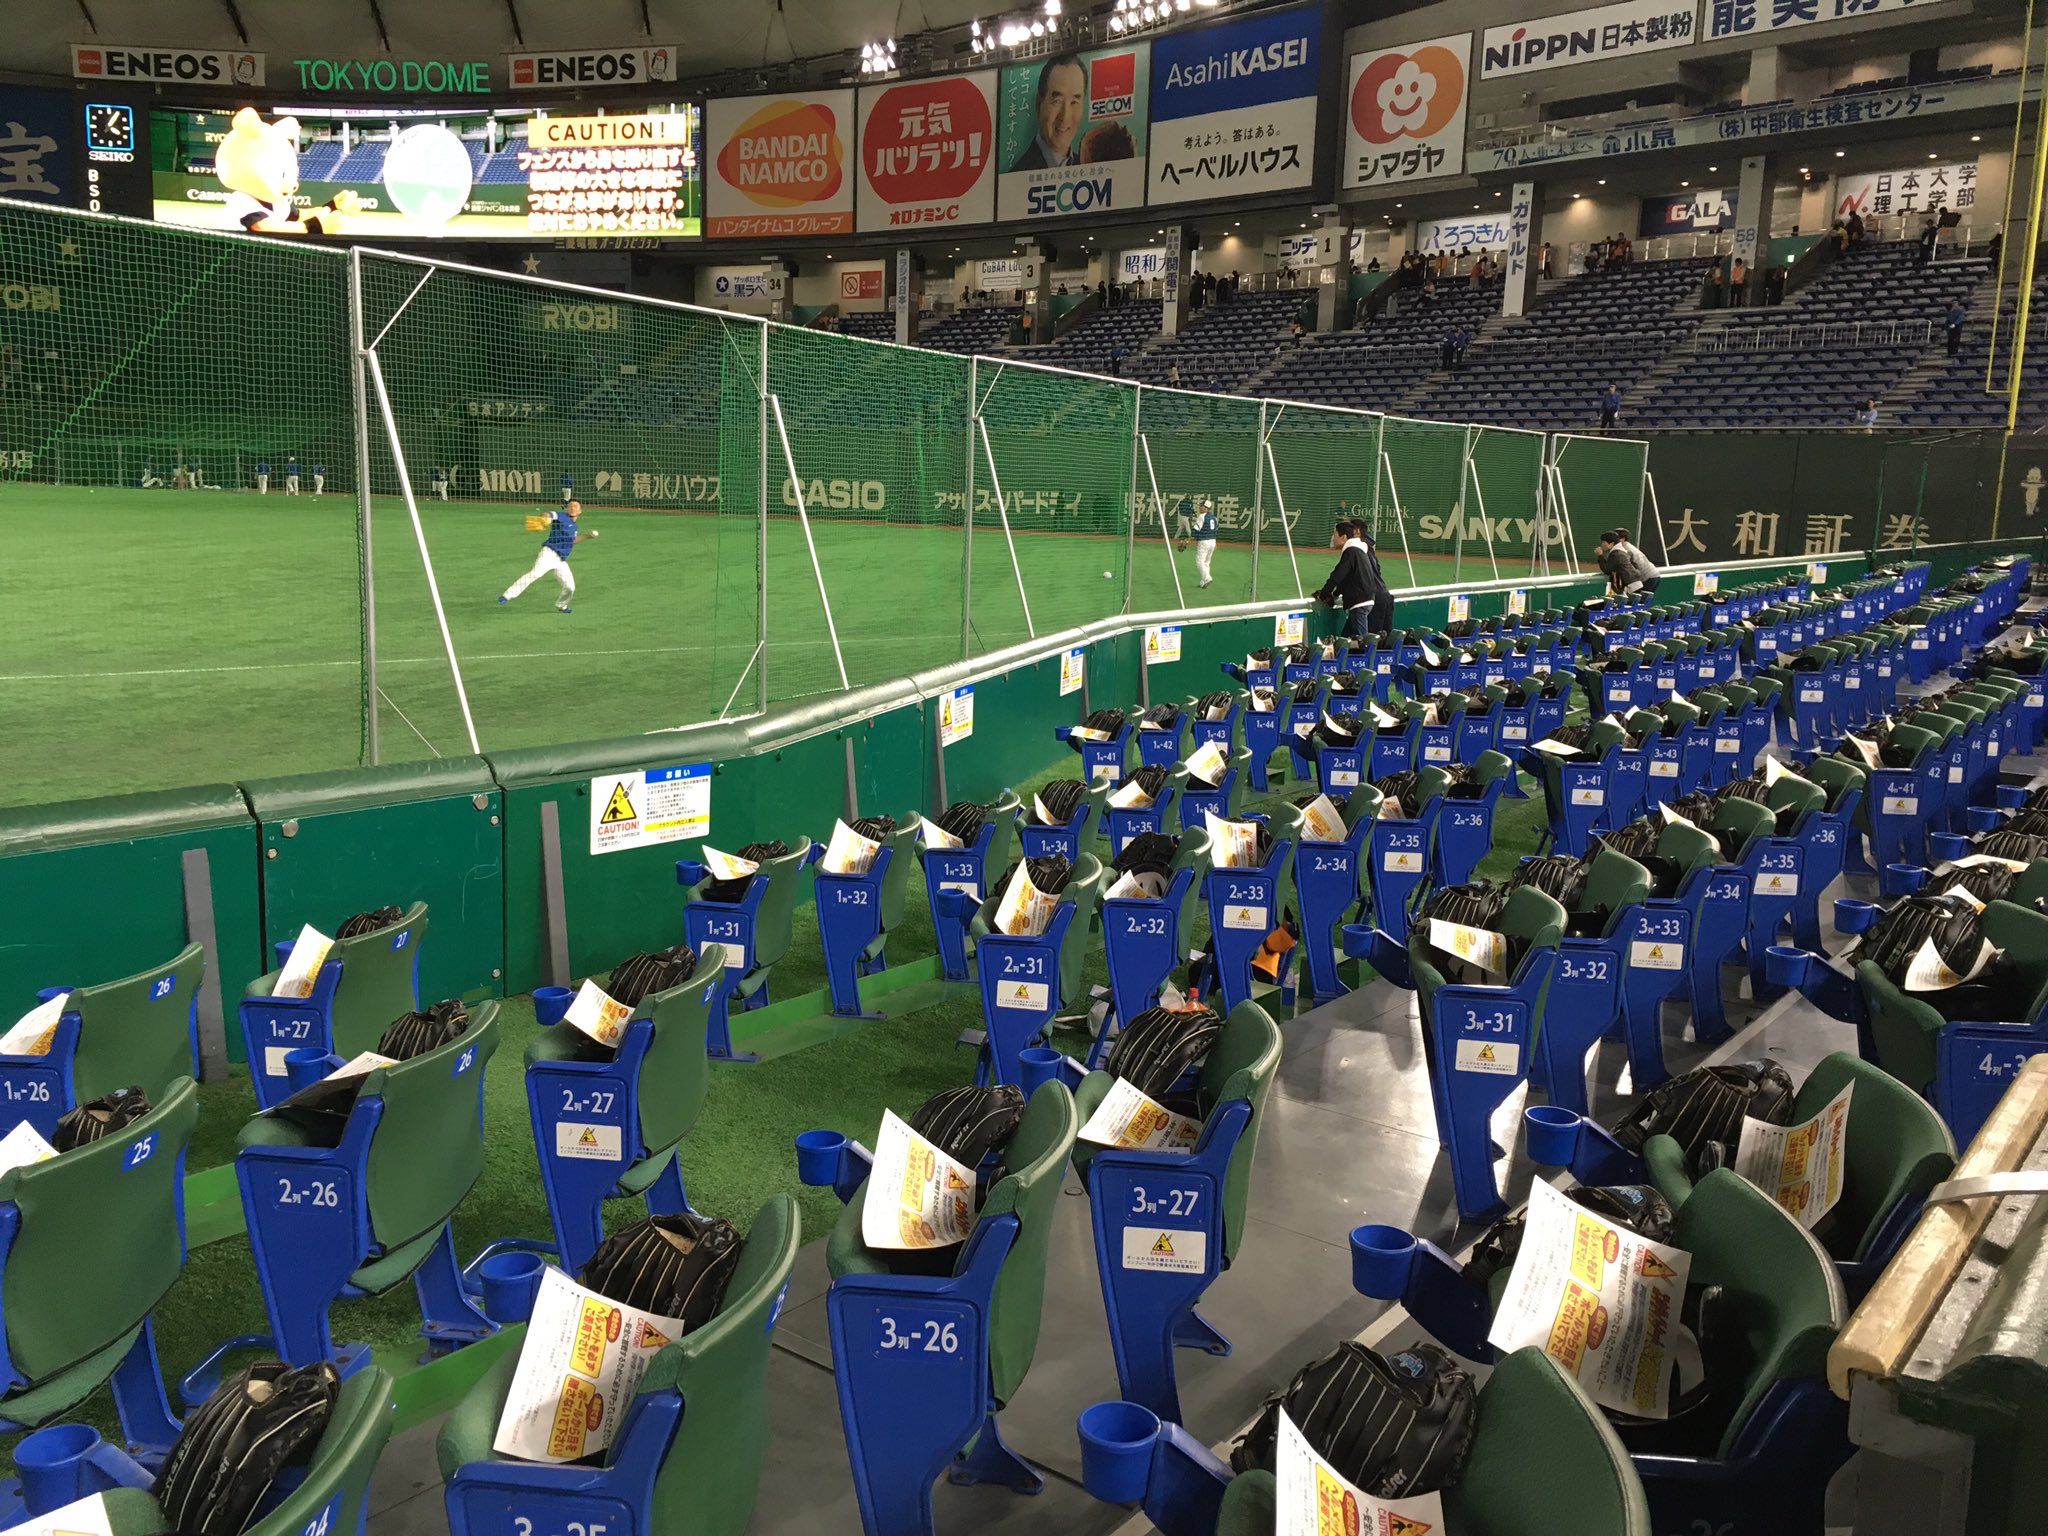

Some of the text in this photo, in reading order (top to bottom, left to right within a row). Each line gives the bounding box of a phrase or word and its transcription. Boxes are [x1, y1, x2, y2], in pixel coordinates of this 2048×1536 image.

[1601, 11, 1694, 51] 日本製粉
[106, 51, 221, 80] ENEOS
[537, 54, 636, 83] ENEOS
[1165, 37, 1308, 90] AsahiKASEI
[294, 59, 491, 93] TOKYO DOME
[1091, 97, 1132, 116] SECOM
[899, 101, 952, 139] 元気
[1006, 69, 1018, 167] してますか?
[549, 122, 666, 142] CAUTION!
[1183, 123, 1281, 150] 考えよう。答はある。
[89, 151, 134, 163] SEIKO
[739, 133, 827, 160] BANDAI
[873, 132, 983, 178] ハツラツ!
[739, 159, 827, 185] NAMCO
[1161, 144, 1300, 185] ヘーベルハウス
[1358, 143, 1445, 182] シマダヤ
[89, 169, 99, 182] B
[1876, 163, 1977, 194] 日本大学
[89, 184, 100, 198] S
[1027, 178, 1112, 214] SECOM
[1874, 187, 1975, 214] 理工学部
[889, 204, 960, 225] オロナミンC
[1670, 199, 1732, 221] GALA
[716, 215, 844, 235] バンダイナムコ グループ
[1446, 220, 1512, 249] ろうきん
[1735, 228, 1756, 242] 58
[1324, 237, 1331, 253] 1
[1509, 201, 1531, 276] ガヤルド
[1026, 264, 1034, 278] 3
[734, 283, 767, 298] 黒ラベ
[769, 278, 782, 290] 34
[543, 304, 618, 331] RYOBI
[632, 472, 722, 502] 積水ハウス
[782, 478, 885, 511] CASIO
[1351, 503, 1383, 520] Good
[1419, 502, 1568, 546] SANKYO
[1666, 508, 1932, 556] 大和証券
[1333, 758, 1356, 769] 2列-41
[1577, 774, 1602, 786] 3列-41
[1887, 781, 1915, 795] 4列-41
[598, 821, 640, 836] CAUTION!
[1126, 819, 1152, 833] 1列-35
[1454, 813, 1483, 827] 2列-36
[1041, 839, 1068, 854] 1列-34
[1389, 833, 1420, 847] 2列-35
[944, 863, 974, 878] 1列-33
[1315, 856, 1347, 872] 2列-34
[836, 889, 868, 905] 1列-32
[1229, 884, 1264, 901] 2列-33
[707, 919, 740, 938] 1列-31
[1126, 916, 1165, 935] 2列-32
[1638, 917, 1680, 937] 3列-33
[395, 932, 409, 948] 27
[1004, 955, 1044, 975] 2列-31
[1561, 959, 1607, 981] 3列-32
[156, 977, 170, 997] 26
[269, 1019, 311, 1039] 1列-27
[1465, 1010, 1513, 1034] 3列-31
[457, 1048, 472, 1073] 26
[4, 1081, 50, 1102] 1列-26
[562, 1089, 615, 1114] 2列-27
[131, 1136, 152, 1165] 25
[279, 1178, 338, 1208] 2列-26
[1131, 1186, 1199, 1217] 3列-27
[585, 1307, 608, 1372] ヘルメットを必ず
[632, 1317, 644, 1348] CAUTION!
[880, 1316, 959, 1354] 3列-26
[565, 1391, 588, 1452] ボールから目を
